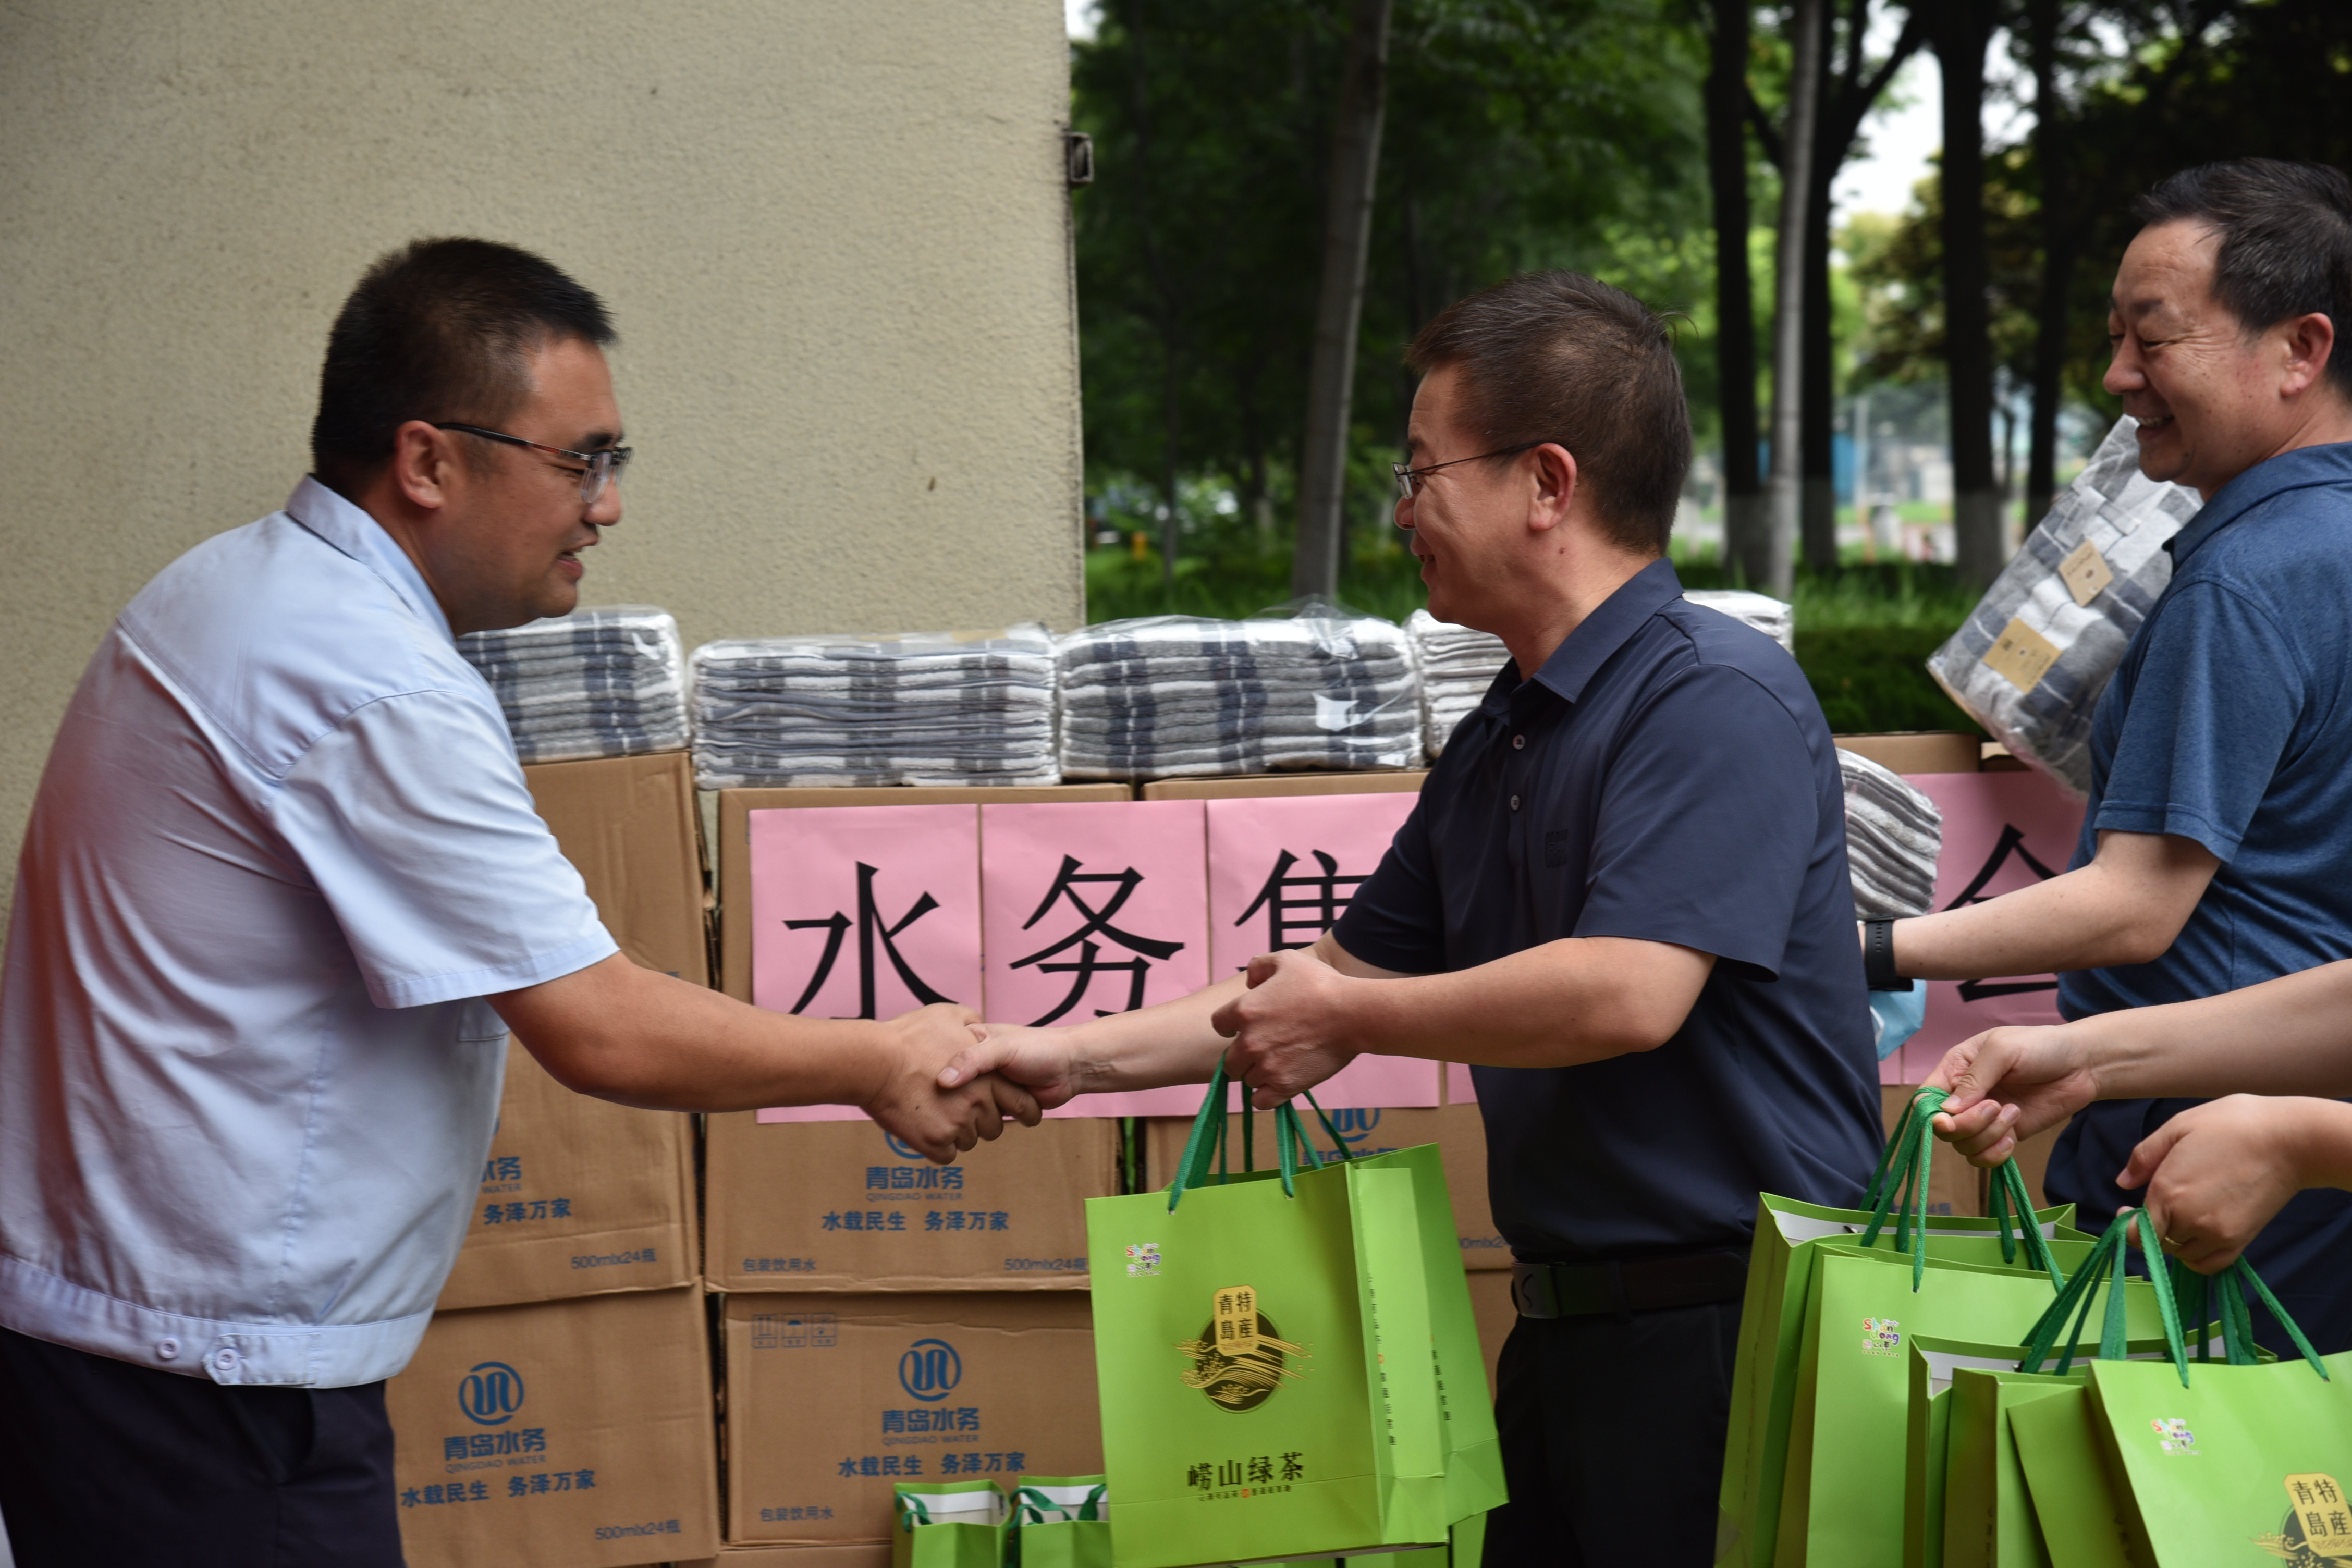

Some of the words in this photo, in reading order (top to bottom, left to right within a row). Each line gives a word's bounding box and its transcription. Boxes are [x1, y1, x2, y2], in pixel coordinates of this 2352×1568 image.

[482, 1183, 521, 1193] WATER
[866, 1166, 964, 1190] 青岛水务
[925, 1192, 963, 1200] WATER
[483, 1198, 572, 1225] 务泽万家
[822, 1211, 906, 1232] 水载民生
[924, 1210, 1010, 1231] 务泽万家
[743, 1257, 817, 1272] 包装饮用水
[1863, 1317, 1894, 1332] Shan
[1870, 1331, 1900, 1346] dong
[882, 1407, 979, 1434] 青岛水务
[444, 1428, 546, 1461] 青岛水务
[942, 1434, 979, 1443] WATER
[507, 1454, 546, 1466] WATER
[839, 1456, 923, 1478] 水载民生
[941, 1452, 1026, 1475] 务泽万家
[1187, 1451, 1304, 1491] 崂山绿茶
[400, 1480, 490, 1508] 水载民生
[508, 1469, 596, 1497] 务泽万家
[2292, 1480, 2328, 1537] 青島
